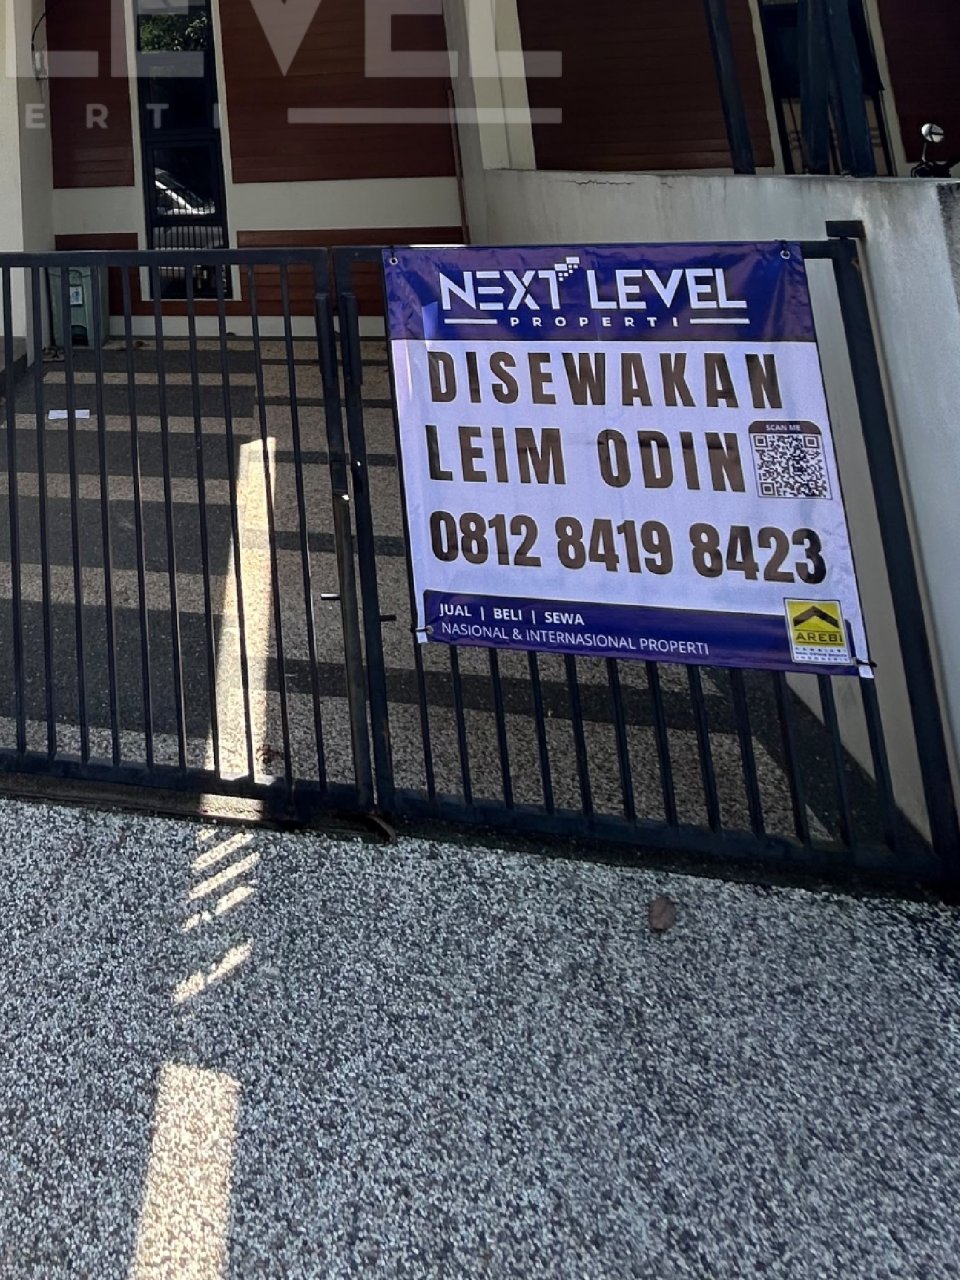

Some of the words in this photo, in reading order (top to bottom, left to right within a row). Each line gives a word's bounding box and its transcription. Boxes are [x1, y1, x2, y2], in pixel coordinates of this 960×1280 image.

[439, 269, 561, 311] NEXT
[586, 268, 748, 310] LEVEL
[510, 316, 679, 327] PROPERTI
[427, 350, 783, 409] DISEWAKAN
[425, 424, 567, 486] LEIM
[597, 428, 747, 493] ODIN
[429, 510, 542, 568] 0812
[554, 516, 674, 575] 8419
[689, 522, 827, 585] 8423
[439, 603, 472, 617] JUAL
[493, 608, 523, 621] BELI
[544, 612, 585, 626] SEWA
[441, 622, 509, 639] NASIONAL
[512, 628, 523, 640] &
[526, 629, 637, 650] INTERNASIONAL
[640, 638, 710, 655] PROPERTI
